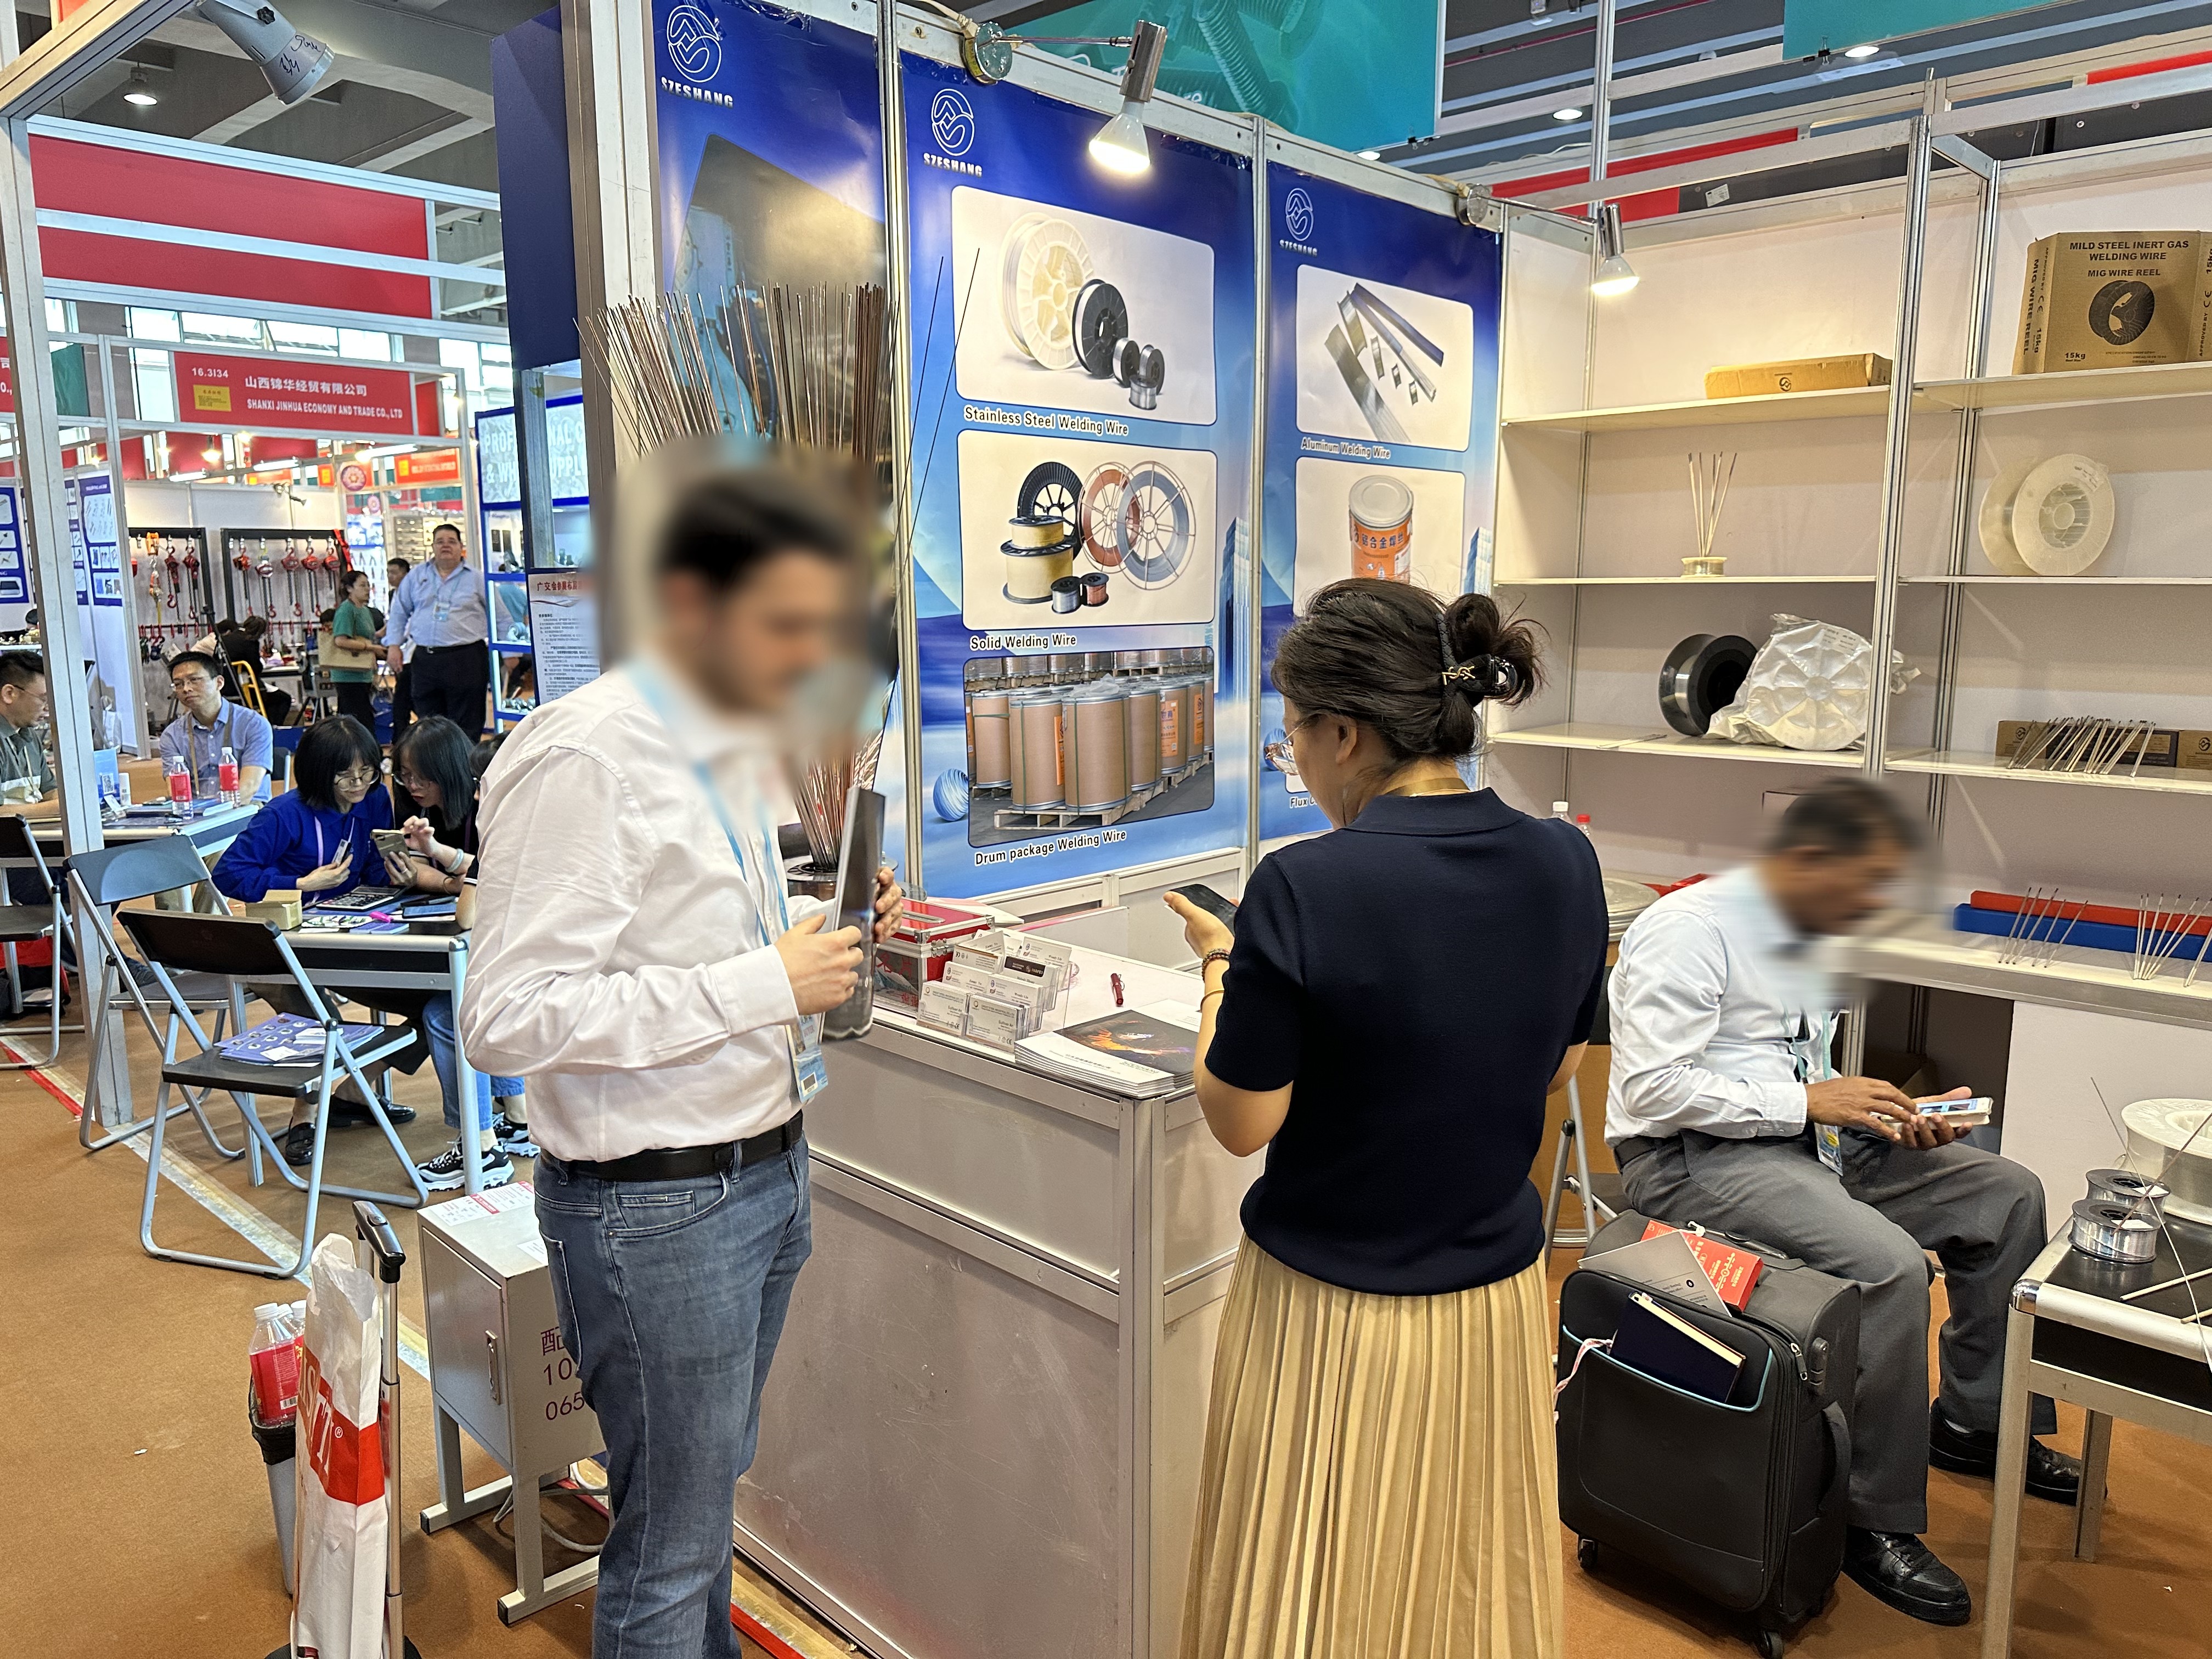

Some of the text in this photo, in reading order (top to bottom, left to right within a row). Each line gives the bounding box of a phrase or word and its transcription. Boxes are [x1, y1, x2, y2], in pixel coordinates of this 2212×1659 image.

[661, 76, 733, 109] SZESHANG
[923, 153, 982, 177] SZESHANG
[2132, 241, 2164, 249] INERT
[2167, 240, 2189, 249] GAS
[2031, 259, 2039, 283] MIG
[2027, 286, 2035, 319] WIRE
[2064, 352, 2086, 360] 15kg
[245, 375, 368, 397] 山西锦华经贸有限公司
[247, 398, 274, 410] SHANXI
[276, 400, 302, 412] JINHUA
[303, 402, 337, 415] ECONOMY
[338, 404, 352, 415] AND
[353, 405, 375, 417] TRADE
[390, 408, 403, 419] LTD
[966, 407, 1128, 435] Stainless Steel Welding Wire
[1302, 438, 1390, 458] Aluminum Welding Wire
[537, 581, 583, 591] 广交会参展布展
[971, 634, 1076, 649] Solid Welding Wire
[1291, 797, 1307, 807] Flux
[975, 830, 1126, 865] Drum package Welding Wire
[540, 1326, 565, 1356] 配
[545, 1391, 585, 1421] 065
